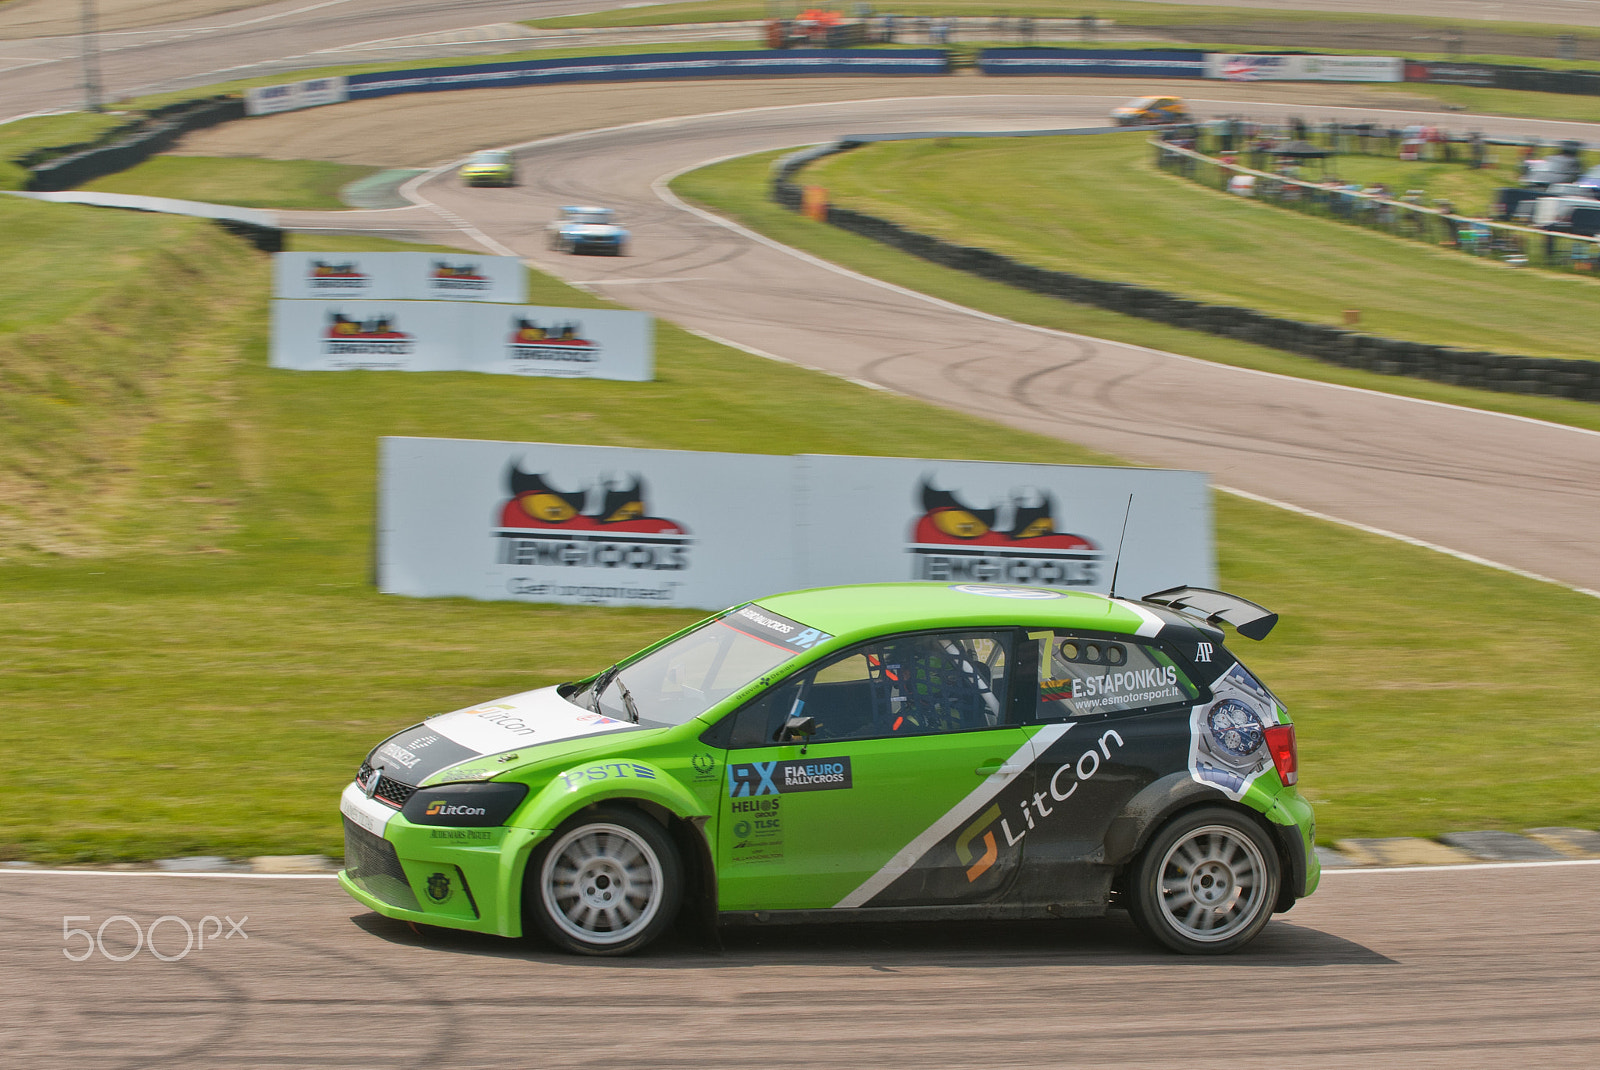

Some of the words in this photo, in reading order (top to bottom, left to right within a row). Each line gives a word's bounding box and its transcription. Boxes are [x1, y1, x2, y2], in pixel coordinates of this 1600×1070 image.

[1027, 630, 1055, 679] 7
[1194, 641, 1213, 663] AP
[1072, 665, 1177, 698] E.STAPONKUS
[1075, 686, 1179, 710] www.esmotorsport.lt
[785, 773, 844, 786] RALLYCROSS
[1001, 729, 1124, 847] LitCon
[439, 805, 486, 816] LitCon
[754, 819, 780, 829] TLSC
